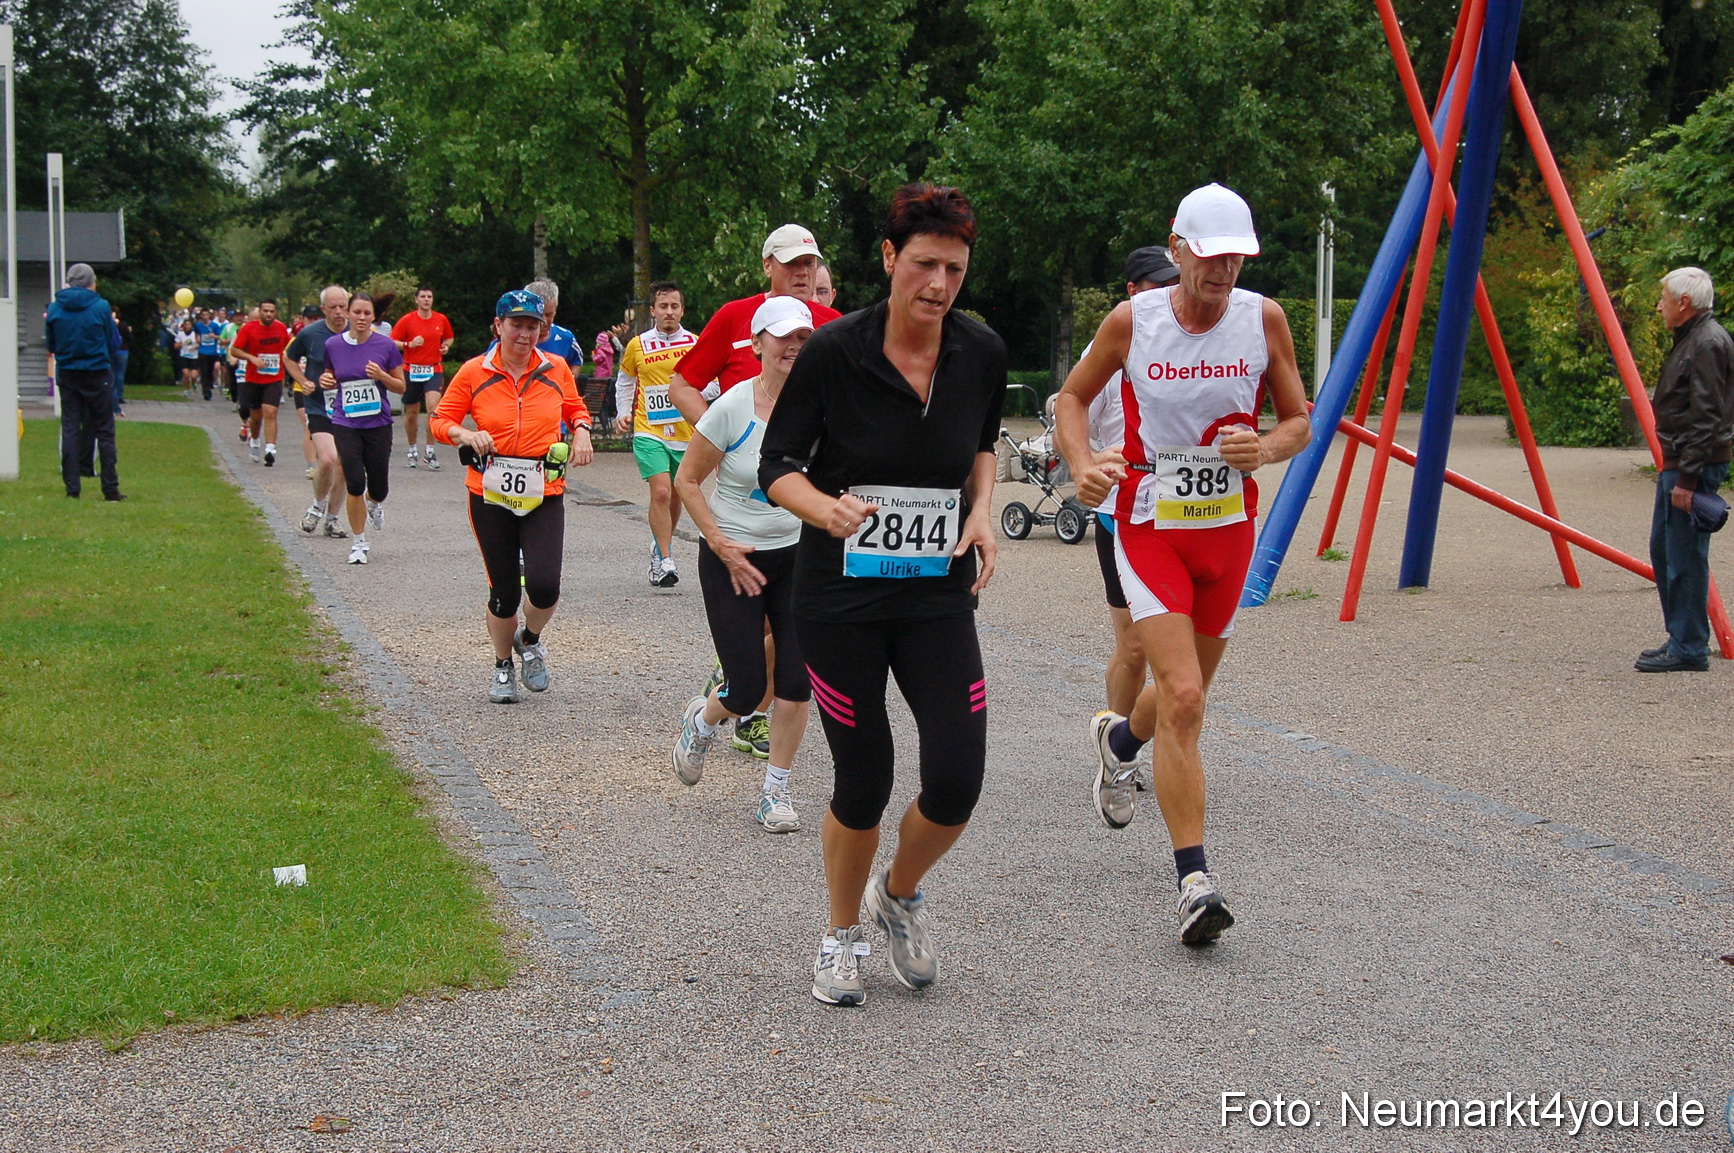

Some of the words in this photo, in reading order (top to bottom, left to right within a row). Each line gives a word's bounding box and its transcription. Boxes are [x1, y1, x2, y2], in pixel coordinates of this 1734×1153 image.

[645, 353, 670, 364] MAX
[412, 365, 432, 373] 2073
[1147, 358, 1249, 380] Oberbank
[345, 387, 375, 404] 2941
[648, 394, 673, 410] 309
[1158, 452, 1190, 462] PARTL
[1192, 455, 1224, 464] Neuma
[507, 464, 534, 472] Neumarkt
[500, 472, 526, 494] 36
[1175, 465, 1230, 497] 389
[501, 496, 522, 509] Helga
[891, 498, 941, 509] Neumarkt
[1183, 505, 1222, 517] Martin
[857, 512, 947, 551] 2844
[880, 561, 921, 576] Ulrike
